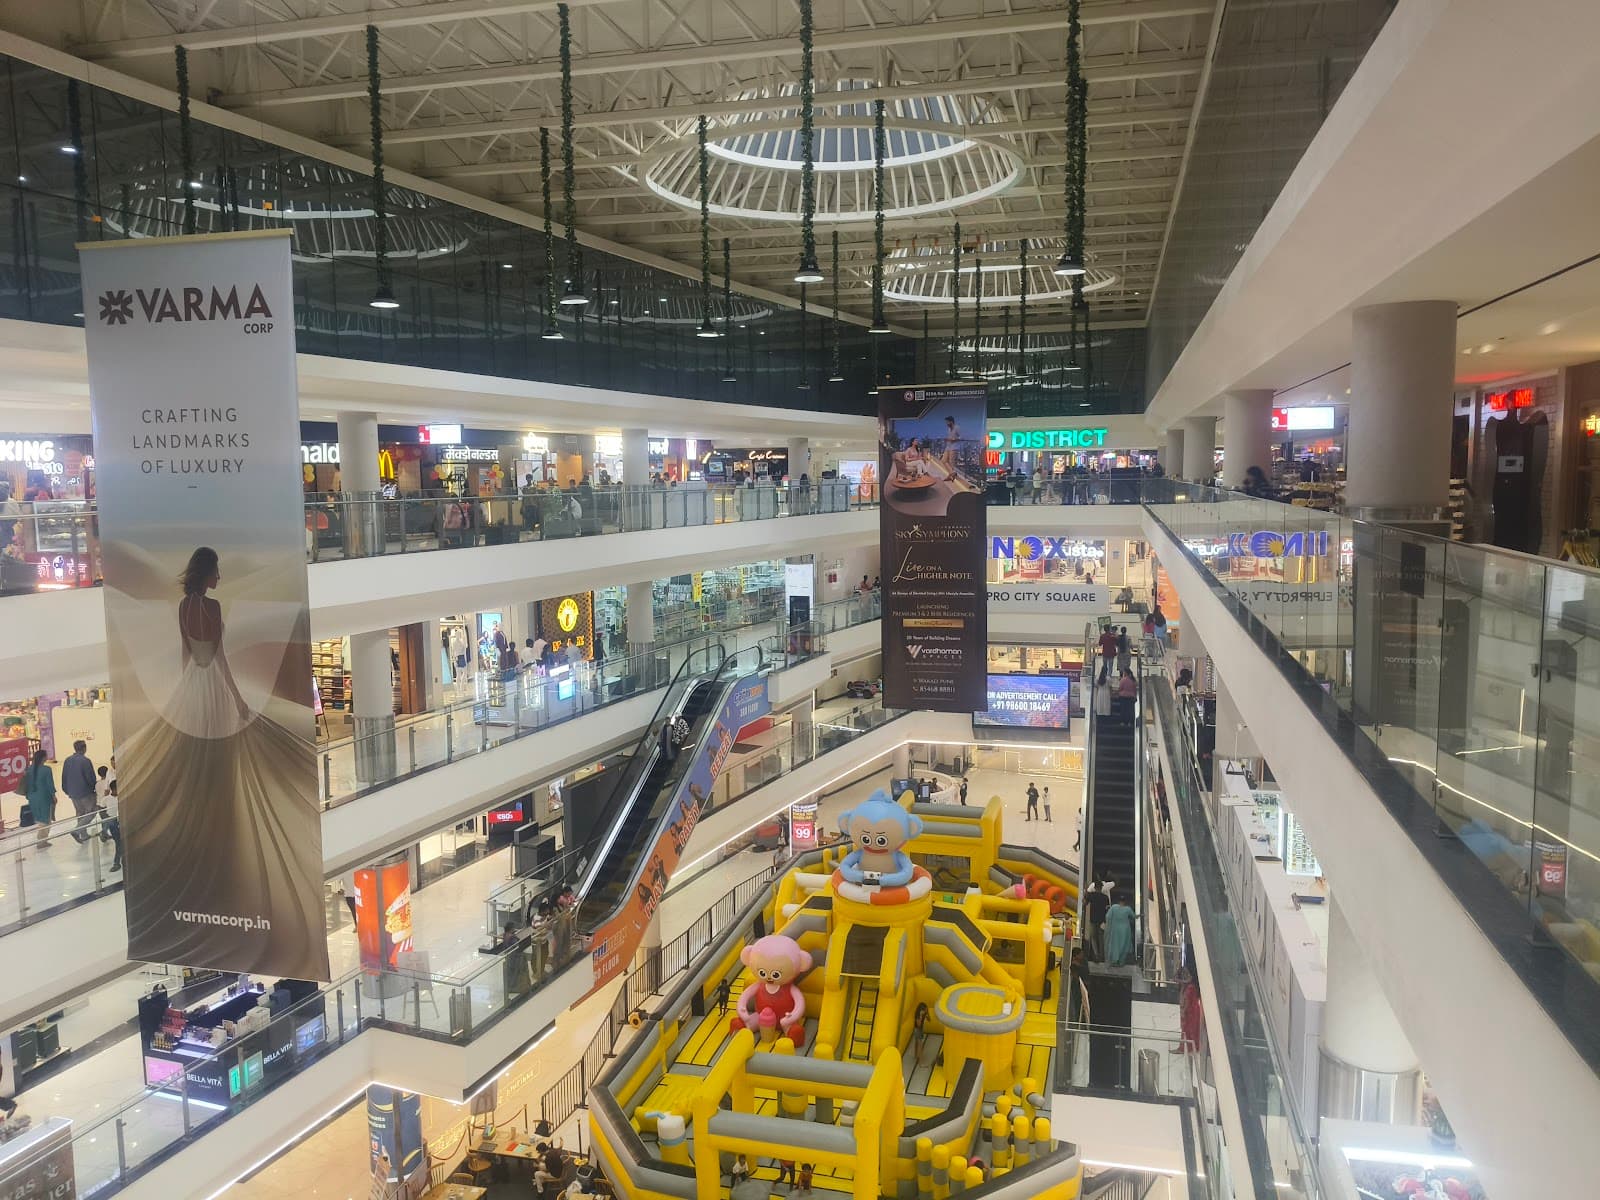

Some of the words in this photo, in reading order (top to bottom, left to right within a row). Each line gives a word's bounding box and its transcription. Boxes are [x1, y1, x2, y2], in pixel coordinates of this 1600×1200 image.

[136, 283, 273, 323] VARMA
[243, 322, 274, 334] CORP
[142, 408, 238, 424] CRAFTING
[133, 433, 250, 449] LANDMARKS
[1011, 429, 1108, 448] DISTRICT
[0, 440, 54, 461] KING
[141, 461, 164, 474] OF
[171, 459, 244, 474] LUXURY
[915, 529, 969, 538] SYMPHONY
[985, 535, 1067, 561] NOX
[917, 572, 948, 580] HIGHER
[1014, 592, 1040, 602] CITY
[1046, 592, 1096, 602] SQUARE
[921, 647, 962, 655] vardhaman
[996, 692, 1042, 700] ADVERTISEMENT
[1043, 693, 1057, 701] CALL
[0, 755, 26, 777] 30
[679, 800, 700, 848] PARTY
[796, 828, 811, 839] 99
[173, 910, 271, 932] varmacorp.in
[263, 1051, 280, 1064] BELLA
[280, 1043, 293, 1055] VITA
[186, 1073, 206, 1084] BELLA
[206, 1077, 222, 1087] VITA
